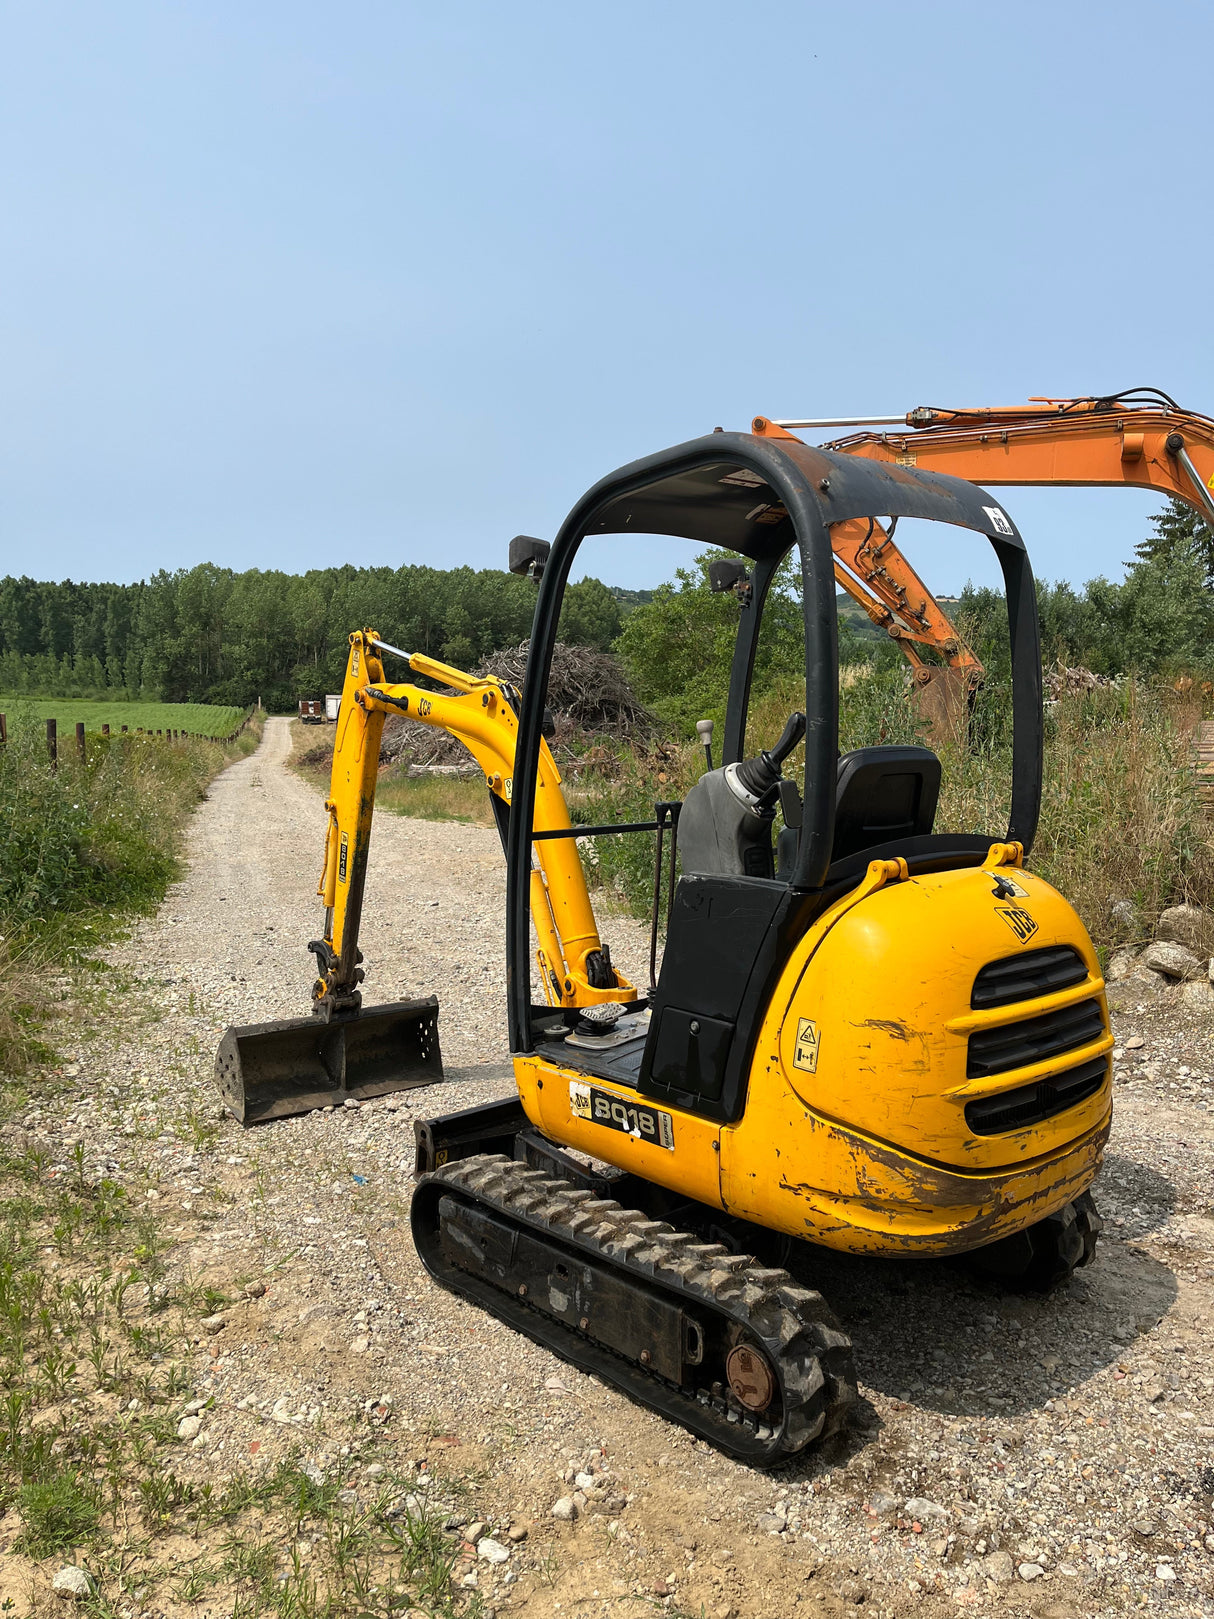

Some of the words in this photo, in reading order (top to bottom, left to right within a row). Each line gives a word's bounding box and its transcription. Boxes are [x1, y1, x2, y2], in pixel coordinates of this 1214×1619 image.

[417, 697, 433, 717] JCB
[1002, 910, 1036, 939] JCB
[575, 1093, 589, 1108] JCB
[595, 1097, 655, 1135] 8018
[662, 1114, 671, 1147] SUPER
